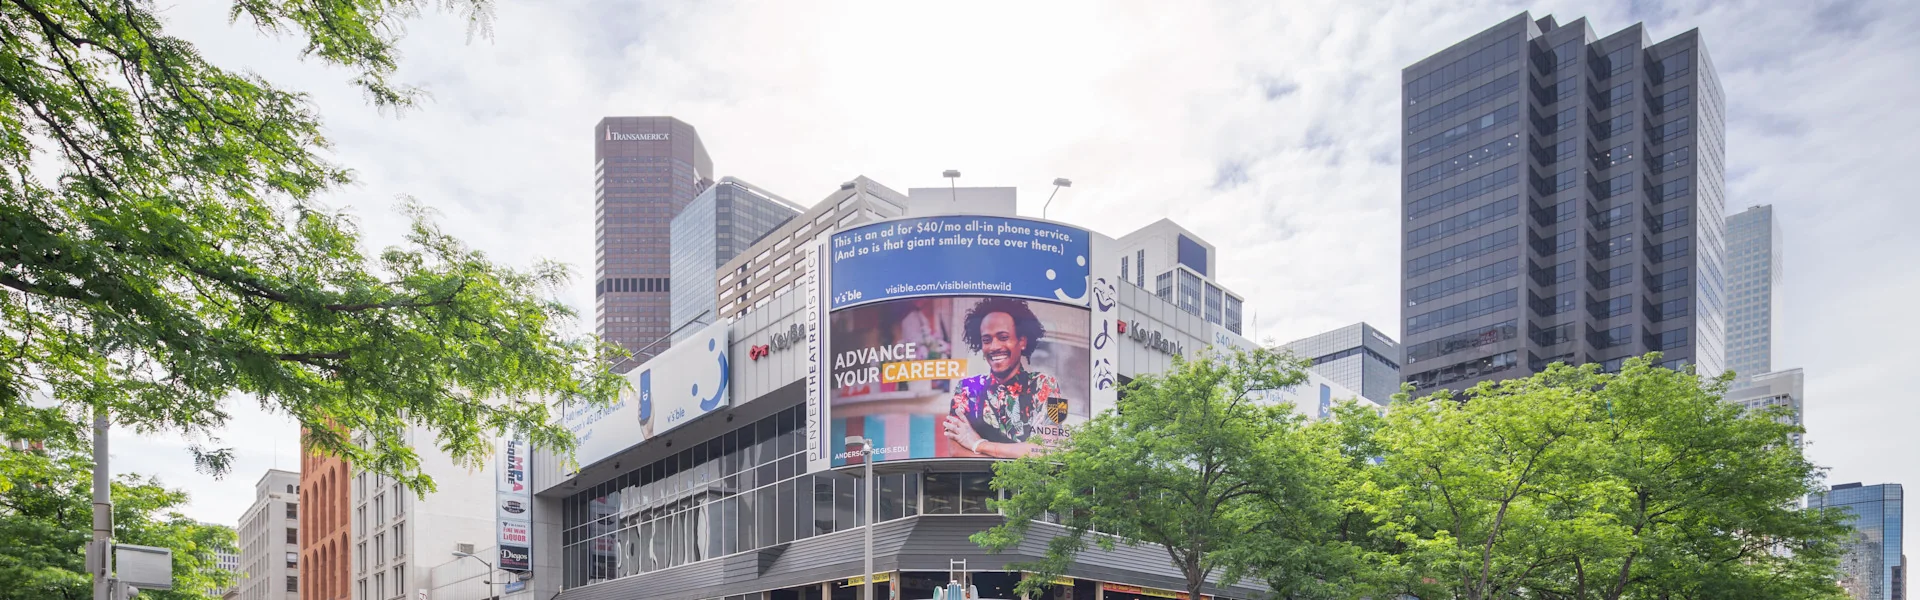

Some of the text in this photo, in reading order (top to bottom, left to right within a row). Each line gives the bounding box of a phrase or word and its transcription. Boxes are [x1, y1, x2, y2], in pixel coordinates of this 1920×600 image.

[612, 132, 669, 140] TRANSAMERICA
[835, 220, 1073, 248] This is an ad for $40/mo all-in phone service.
[835, 234, 1064, 263] (And so is that giant smiley face over there.)
[885, 281, 1012, 295] visible.com/visibleinthewild
[770, 323, 806, 353] KeyBa
[1129, 320, 1184, 357] KeyBank
[834, 342, 917, 370] ADVANCE
[834, 360, 966, 389] YOUR CAREER.
[1031, 426, 1070, 438] ANDERS
[507, 440, 515, 484] SQUARE
[501, 549, 528, 562] Diegos
